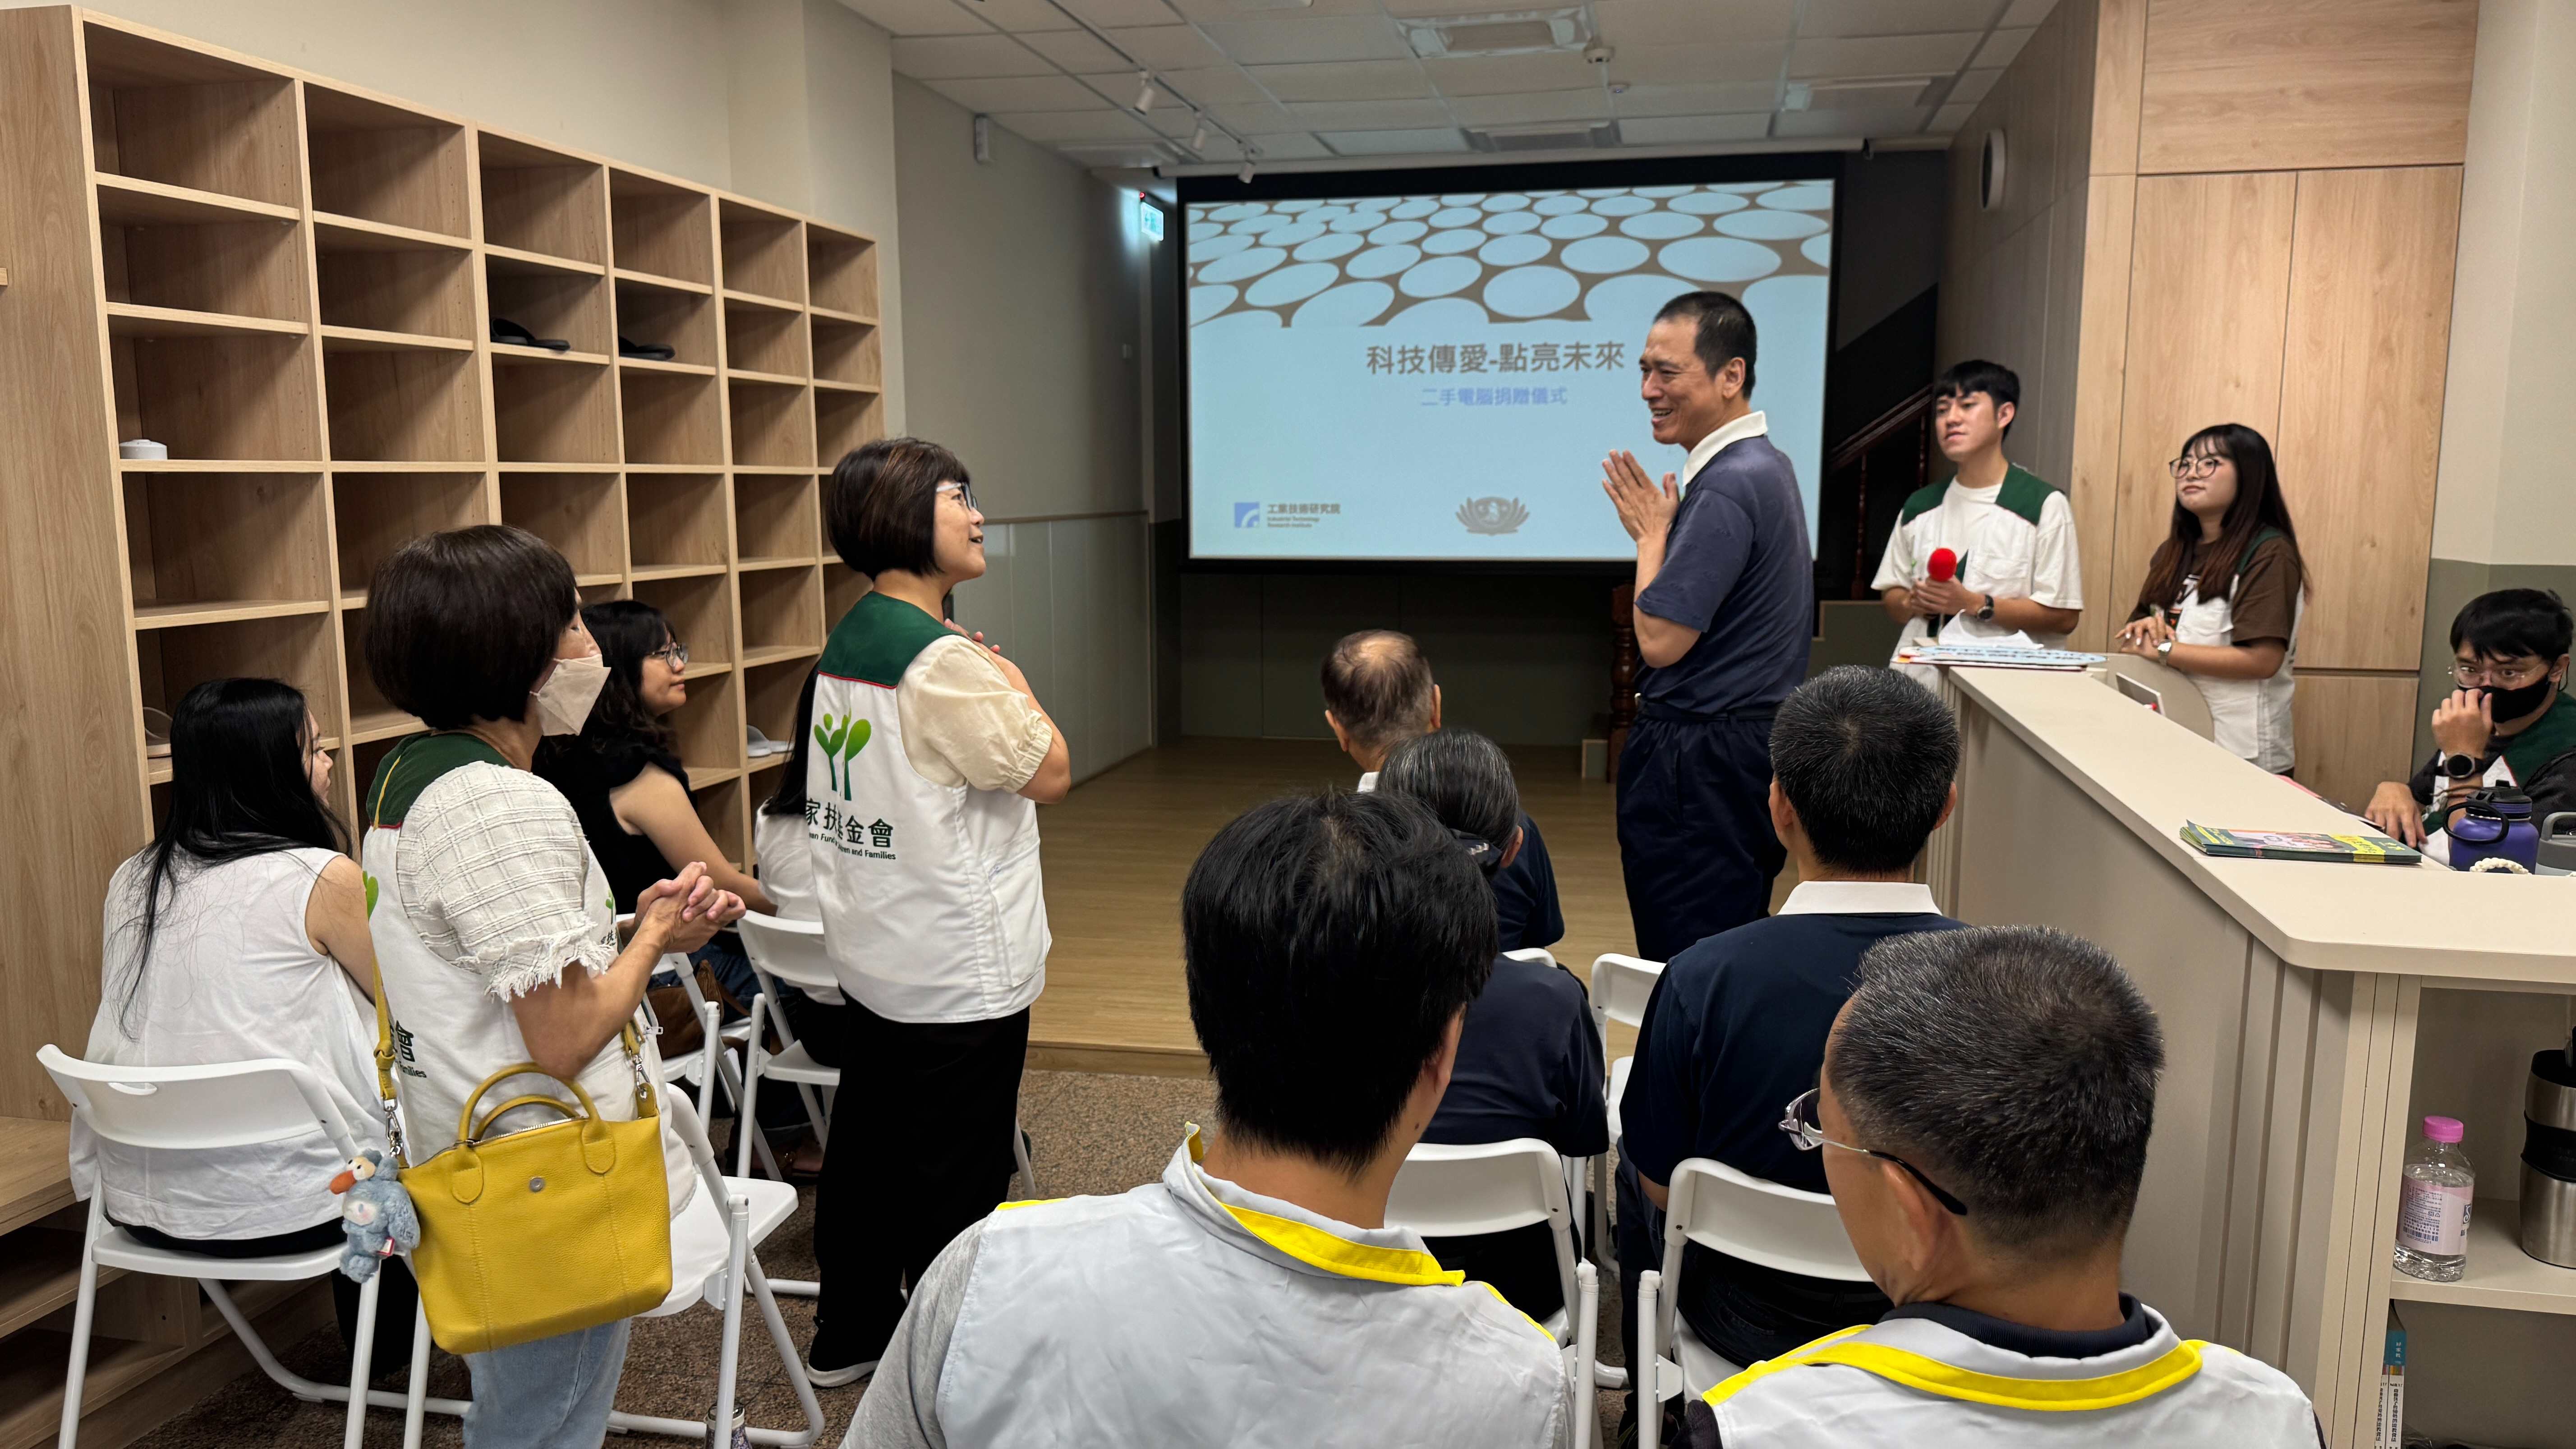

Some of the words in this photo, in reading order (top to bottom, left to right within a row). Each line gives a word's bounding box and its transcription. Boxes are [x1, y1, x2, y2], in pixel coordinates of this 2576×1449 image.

[1366, 341, 1625, 375] 科技傳愛-點亮未來
[1421, 386, 1568, 407] 二手電腦捐贈儀式
[865, 850, 896, 860] Families
